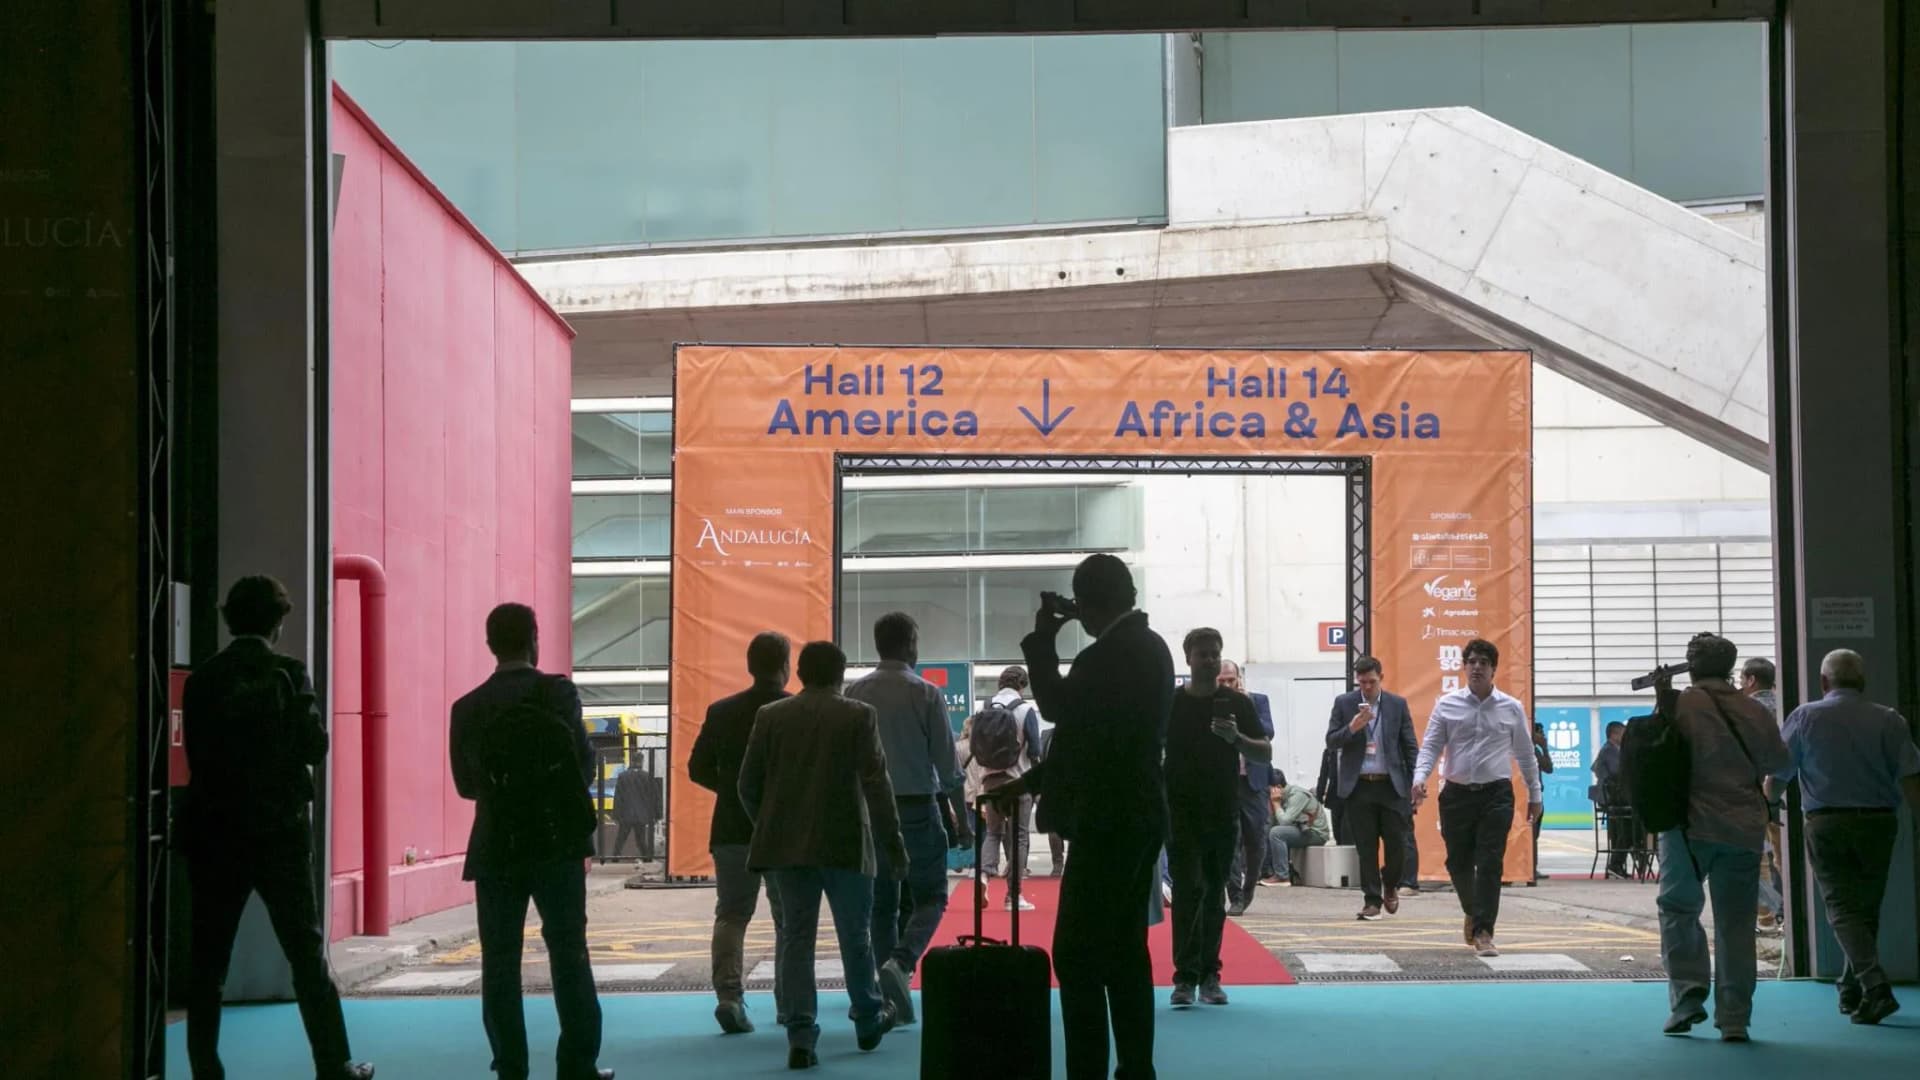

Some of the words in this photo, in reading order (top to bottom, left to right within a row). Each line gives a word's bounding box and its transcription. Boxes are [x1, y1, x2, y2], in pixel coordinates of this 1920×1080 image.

[804, 364, 884, 395] Hall
[900, 365, 944, 396] 12
[1207, 367, 1287, 398] Hall
[1302, 368, 1349, 399] 14
[767, 399, 979, 436] America
[1115, 400, 1265, 438] Africa
[1284, 402, 1317, 439] &
[1336, 402, 1440, 440] Asia
[745, 508, 783, 516] SPONSOR
[1333, 629, 1343, 642] P
[953, 694, 965, 704] 14
